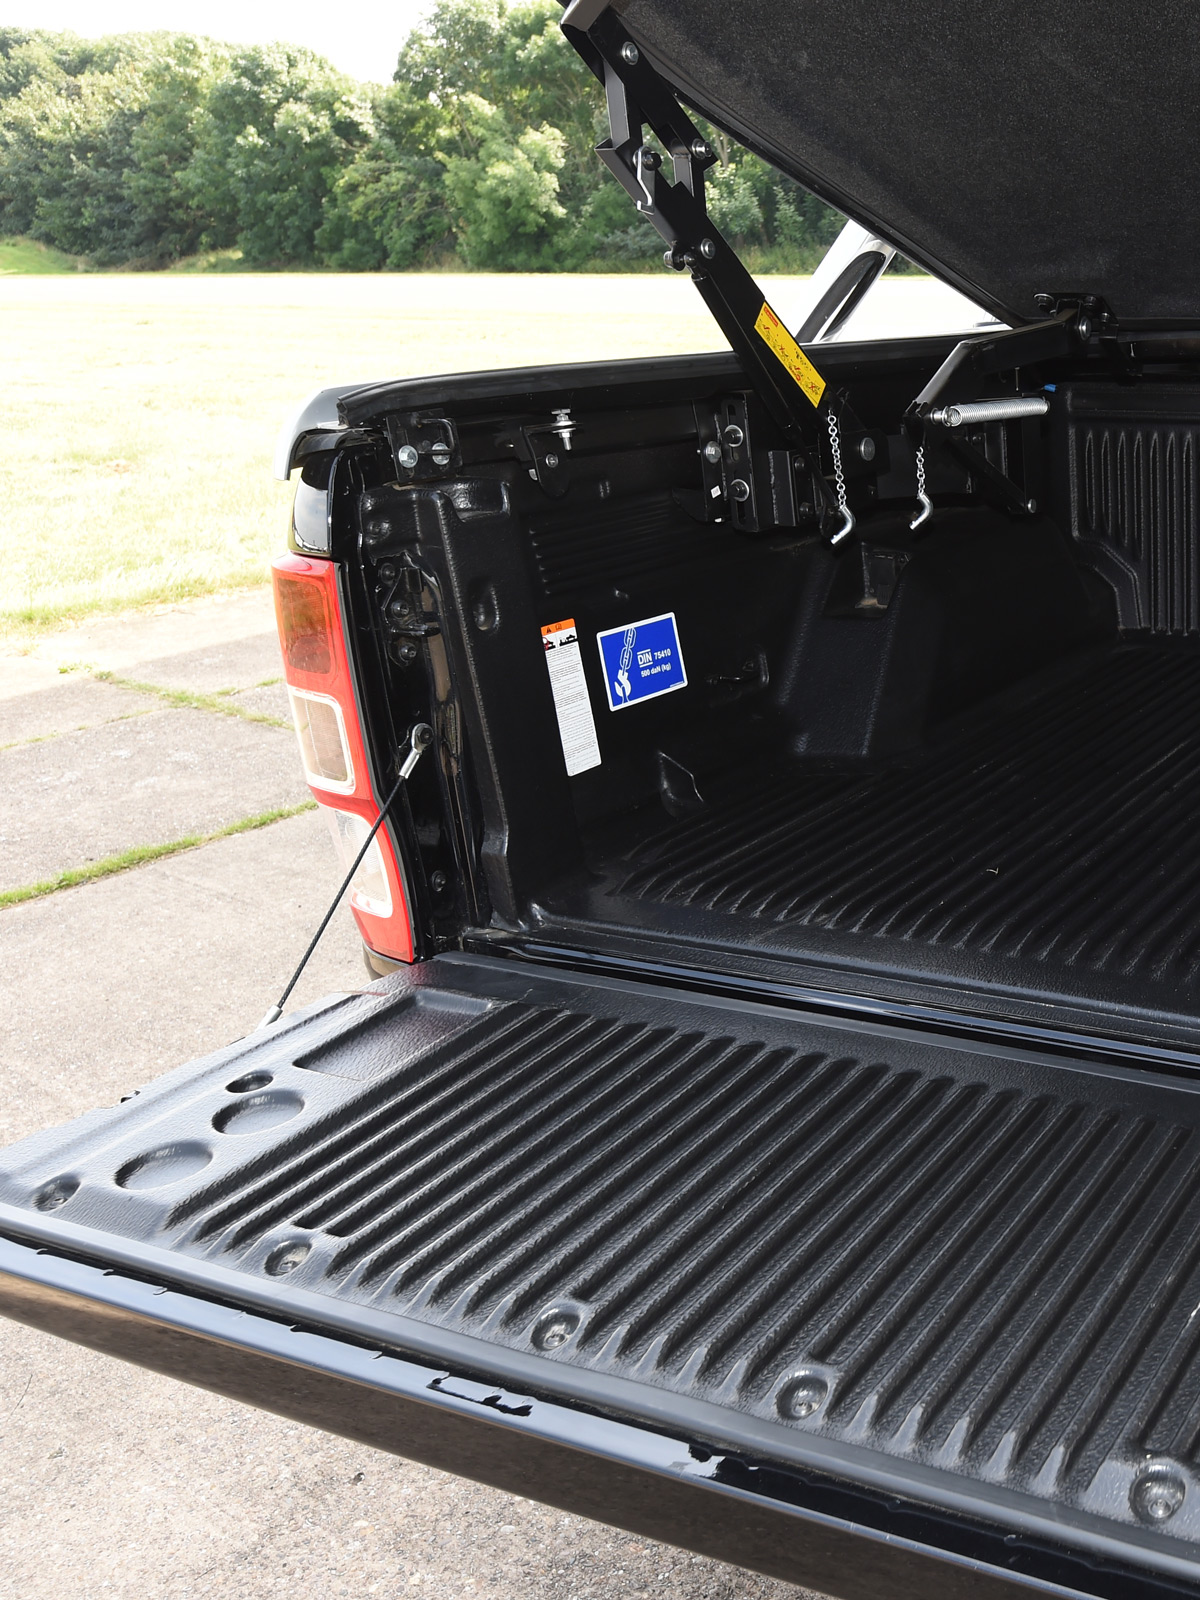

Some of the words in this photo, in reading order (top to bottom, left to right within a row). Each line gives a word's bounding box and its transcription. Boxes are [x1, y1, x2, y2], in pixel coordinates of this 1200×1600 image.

[637, 652, 653, 665] DIN
[654, 648, 671, 660] 75410
[641, 669, 650, 678] 500
[651, 665, 661, 674] daN
[661, 662, 671, 672] (kg)
